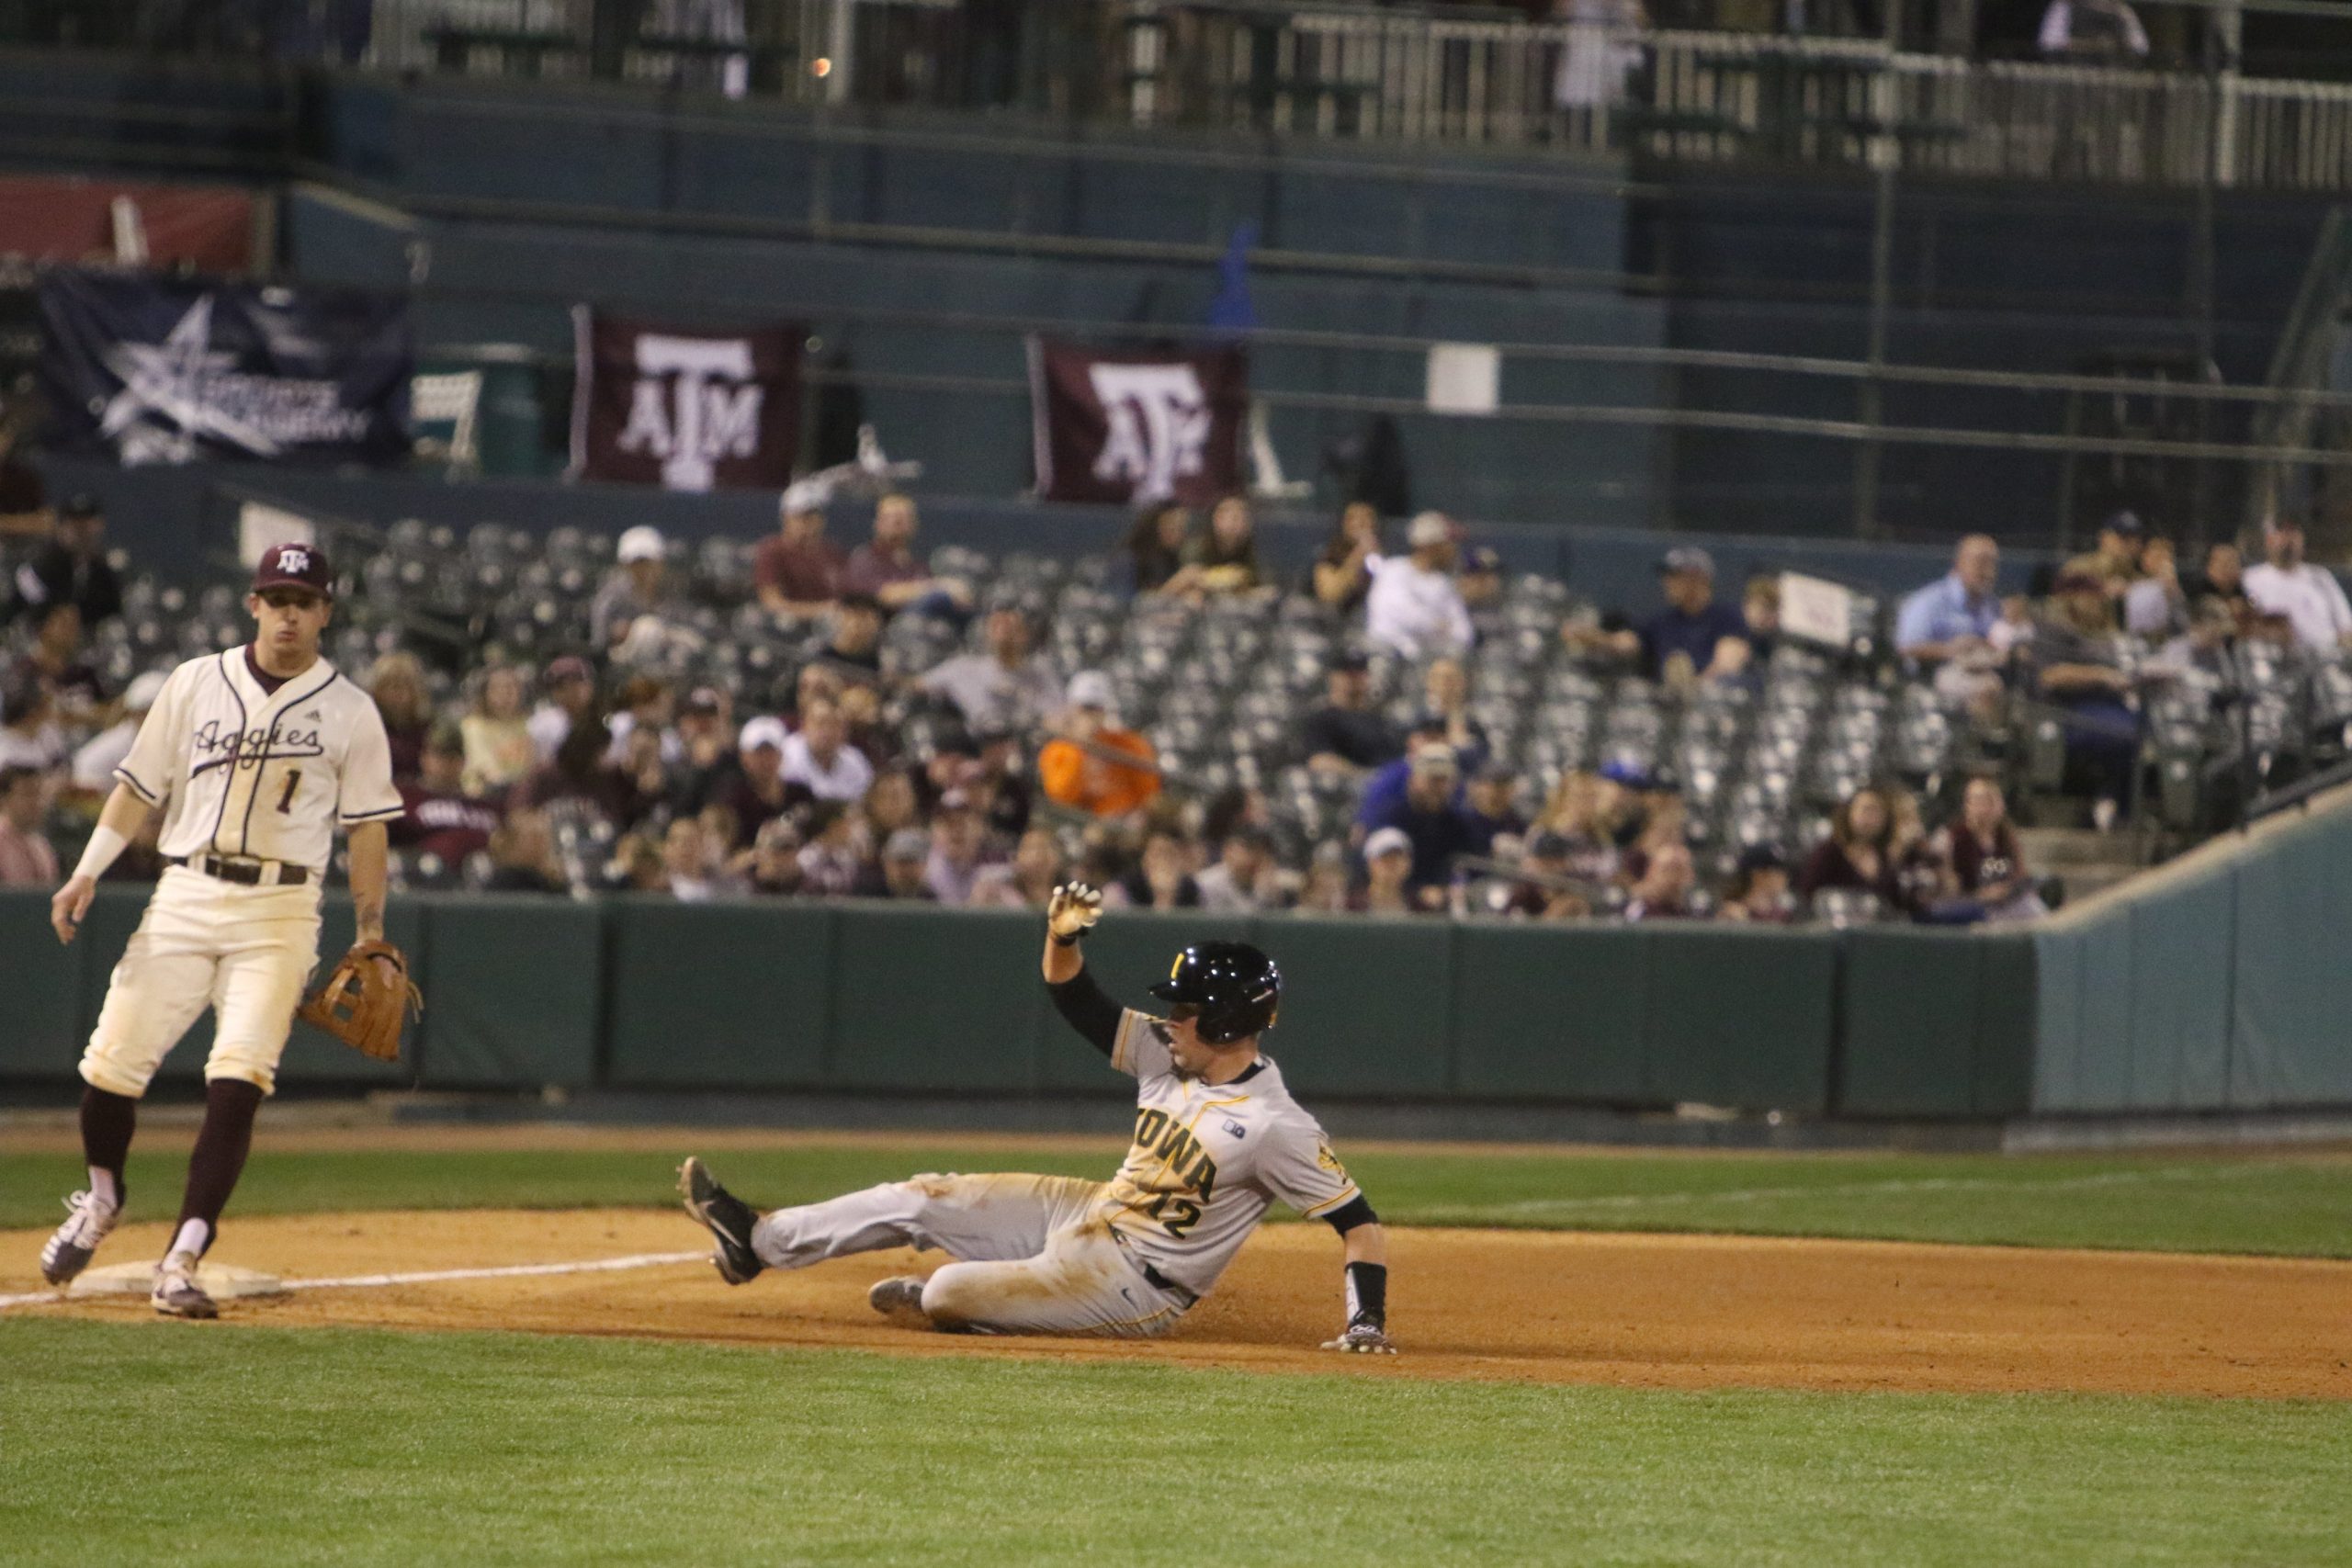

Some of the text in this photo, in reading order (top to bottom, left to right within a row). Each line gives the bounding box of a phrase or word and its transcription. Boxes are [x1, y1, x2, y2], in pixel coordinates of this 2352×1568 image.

[194, 720, 322, 774] Aggies
[277, 770, 301, 815] 1
[1136, 1108, 1217, 1204] OWA
